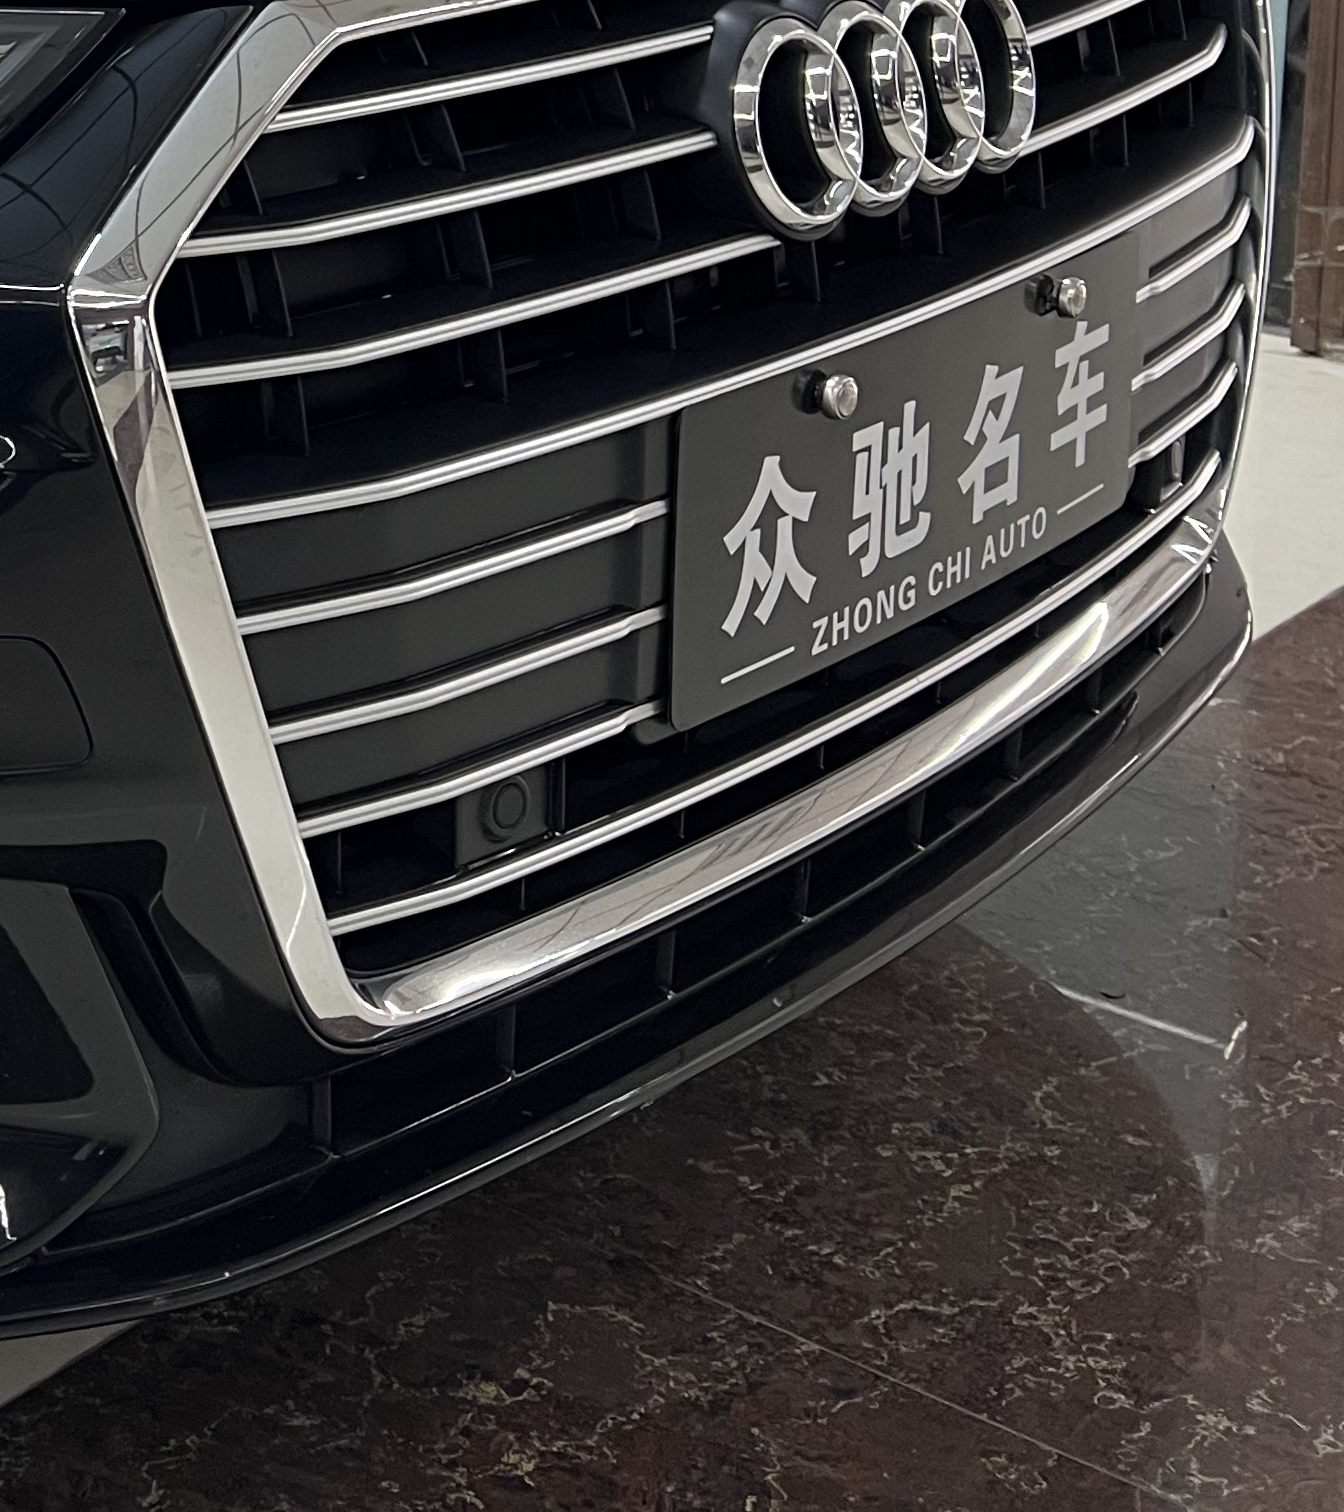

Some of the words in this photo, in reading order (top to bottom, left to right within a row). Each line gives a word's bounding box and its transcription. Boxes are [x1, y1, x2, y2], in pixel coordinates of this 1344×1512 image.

[720, 320, 1110, 638] 众驰名车
[811, 575, 917, 656] ZHONG
[928, 546, 971, 596] CHI
[980, 506, 1047, 570] AUTO
